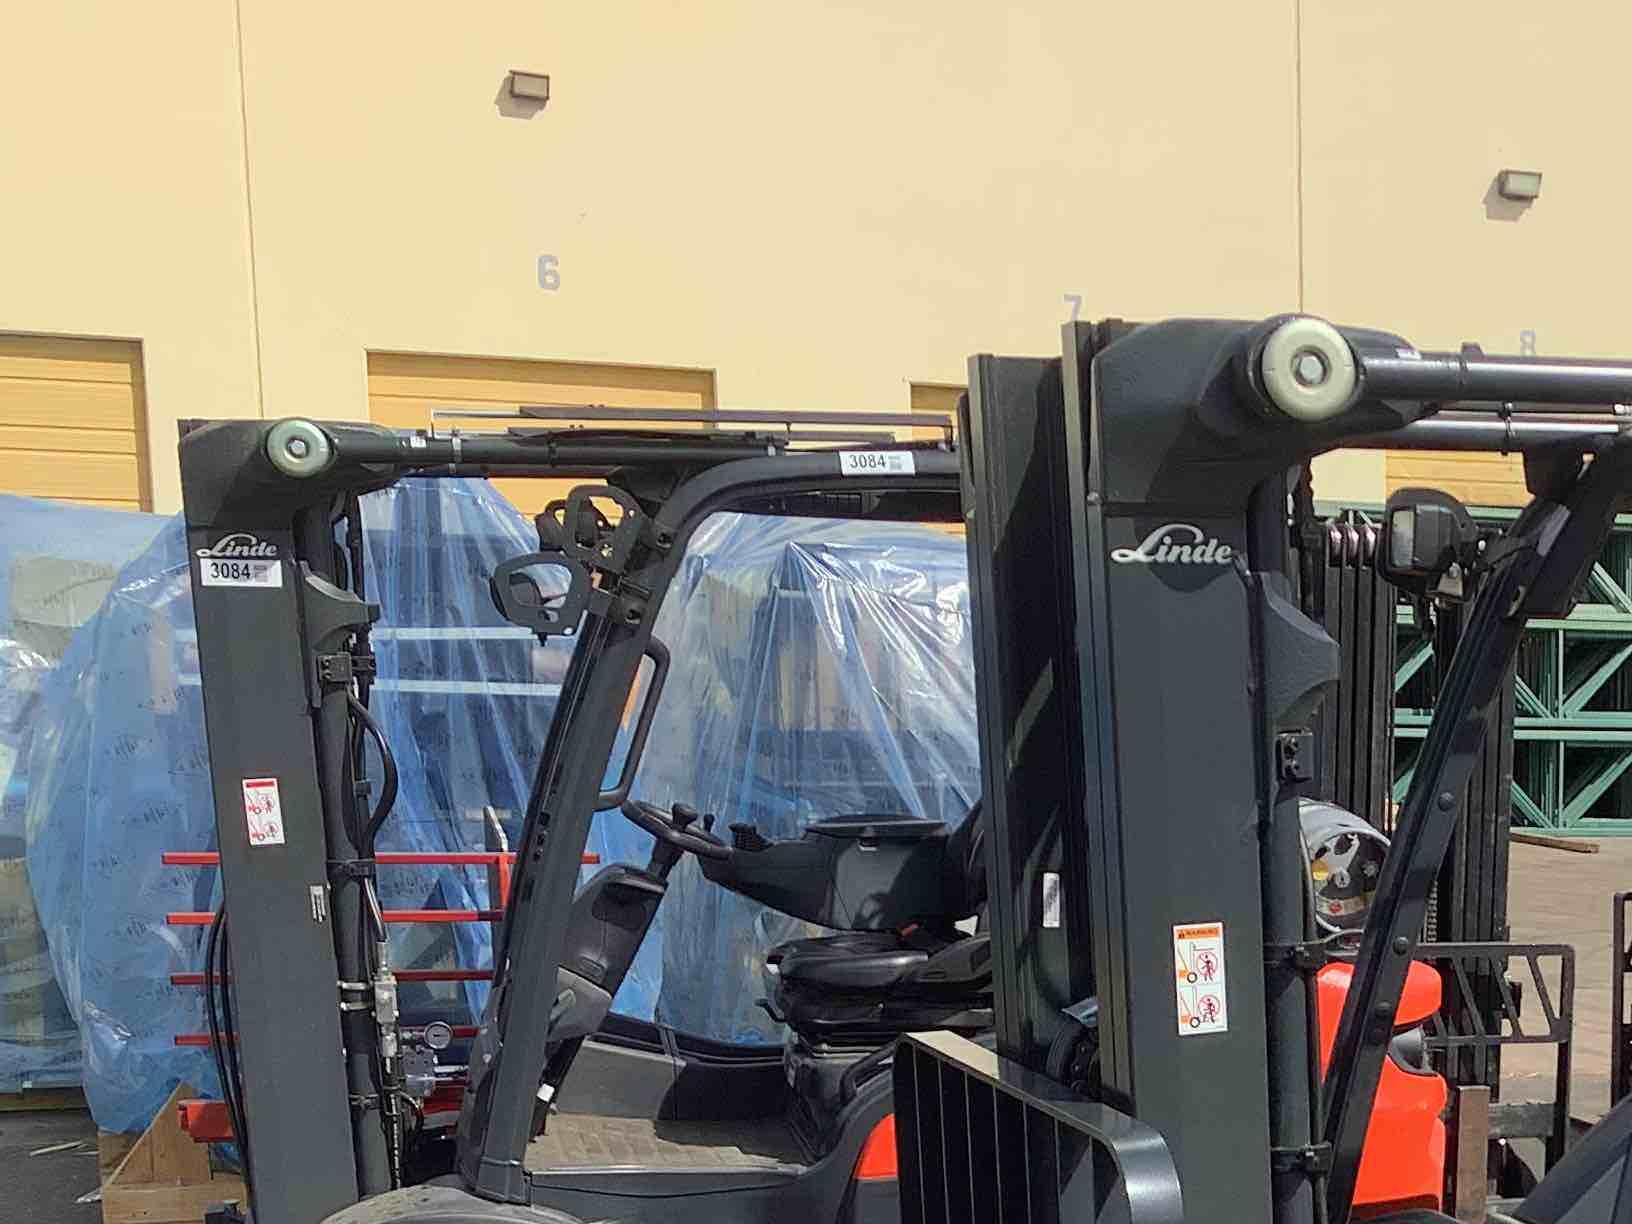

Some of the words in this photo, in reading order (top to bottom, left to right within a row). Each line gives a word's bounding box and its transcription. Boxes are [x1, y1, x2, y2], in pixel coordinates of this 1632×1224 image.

[537, 254, 561, 291] 6
[848, 454, 886, 469] 3084
[196, 532, 277, 557] Linde
[1110, 523, 1232, 564] Linde
[210, 562, 251, 580] 3084
